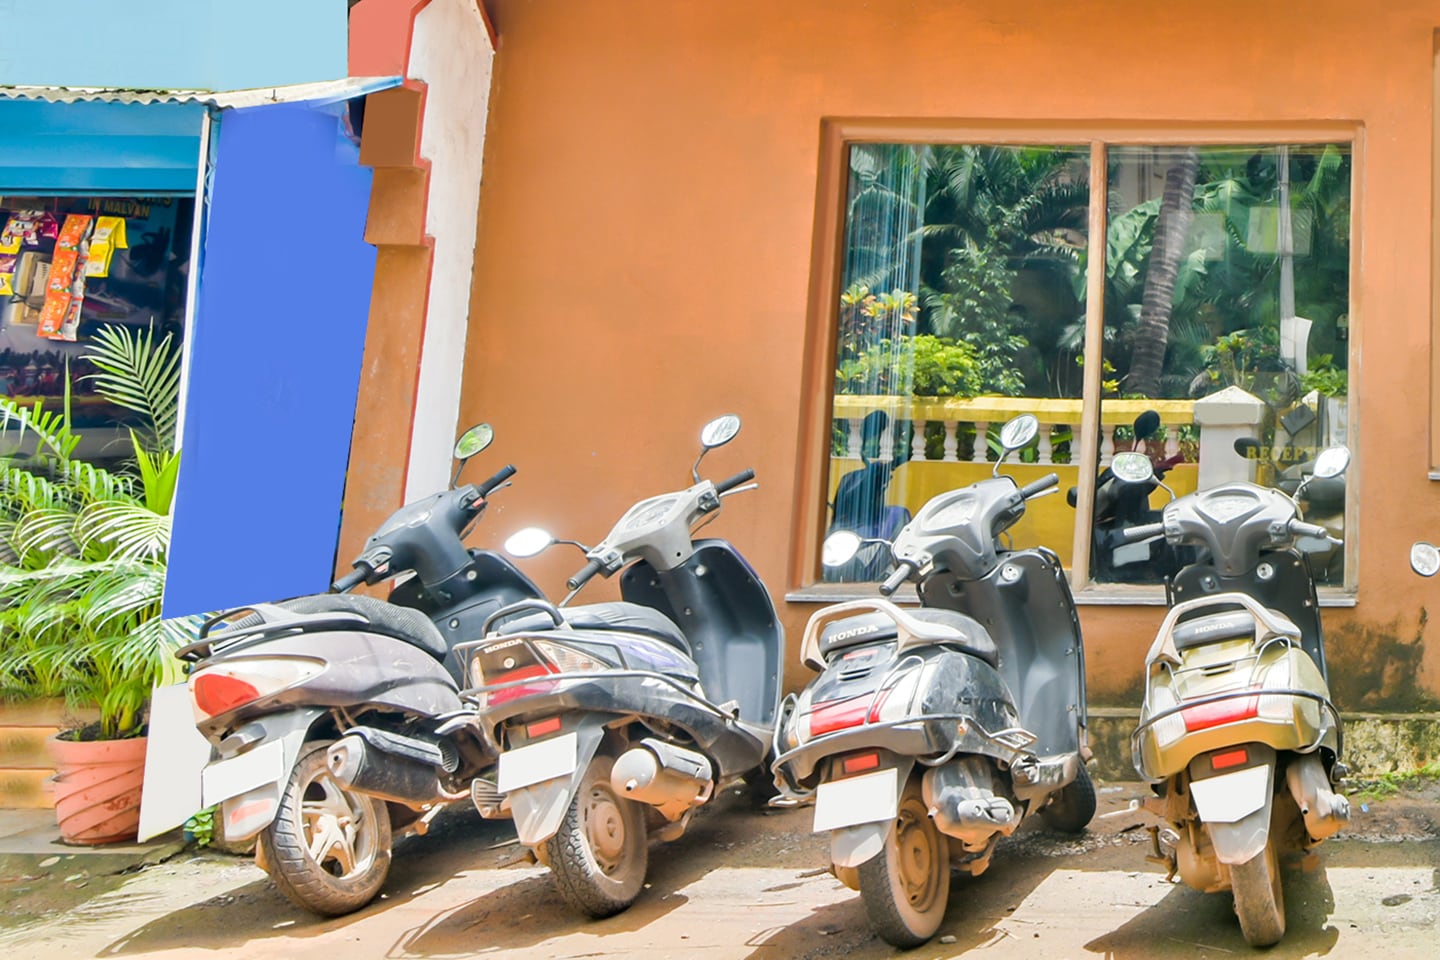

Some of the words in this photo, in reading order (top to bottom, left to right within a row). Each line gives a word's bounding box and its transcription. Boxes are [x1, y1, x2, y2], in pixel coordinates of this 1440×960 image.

[104, 200, 150, 218] MALVAN
[1246, 445, 1322, 461] RECEPT
[828, 624, 879, 644] HONDA
[1194, 622, 1235, 634] HONDA
[483, 638, 523, 654] HONDA
